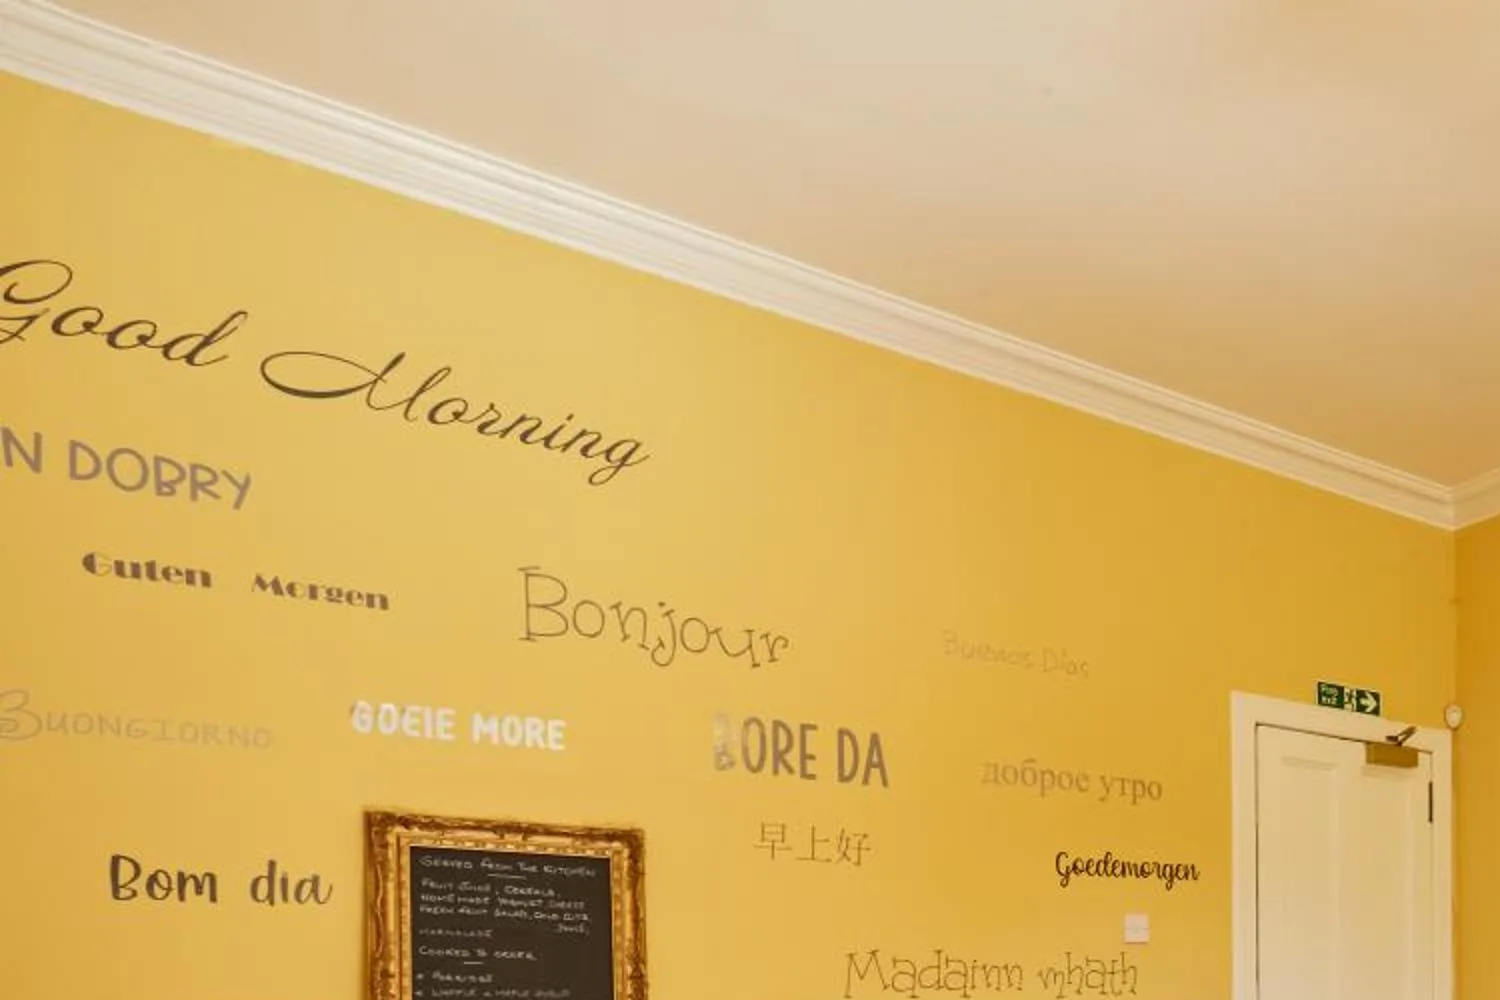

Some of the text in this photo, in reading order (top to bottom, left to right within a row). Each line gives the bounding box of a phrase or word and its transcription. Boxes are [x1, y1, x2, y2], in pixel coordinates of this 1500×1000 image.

[0, 259, 650, 486] Good Morning
[68, 438, 252, 510] DOBRY
[81, 551, 390, 611] Guten Morgen
[517, 566, 789, 668] Bonjour
[350, 699, 567, 751] GOEIE MORE
[836, 727, 889, 788] DA
[980, 758, 1163, 806] доброе утро
[753, 821, 872, 868] 早上好
[110, 854, 333, 906] Bom dia
[1055, 851, 1200, 891] Goedemorgen
[844, 950, 1139, 999] Madainn mhath
